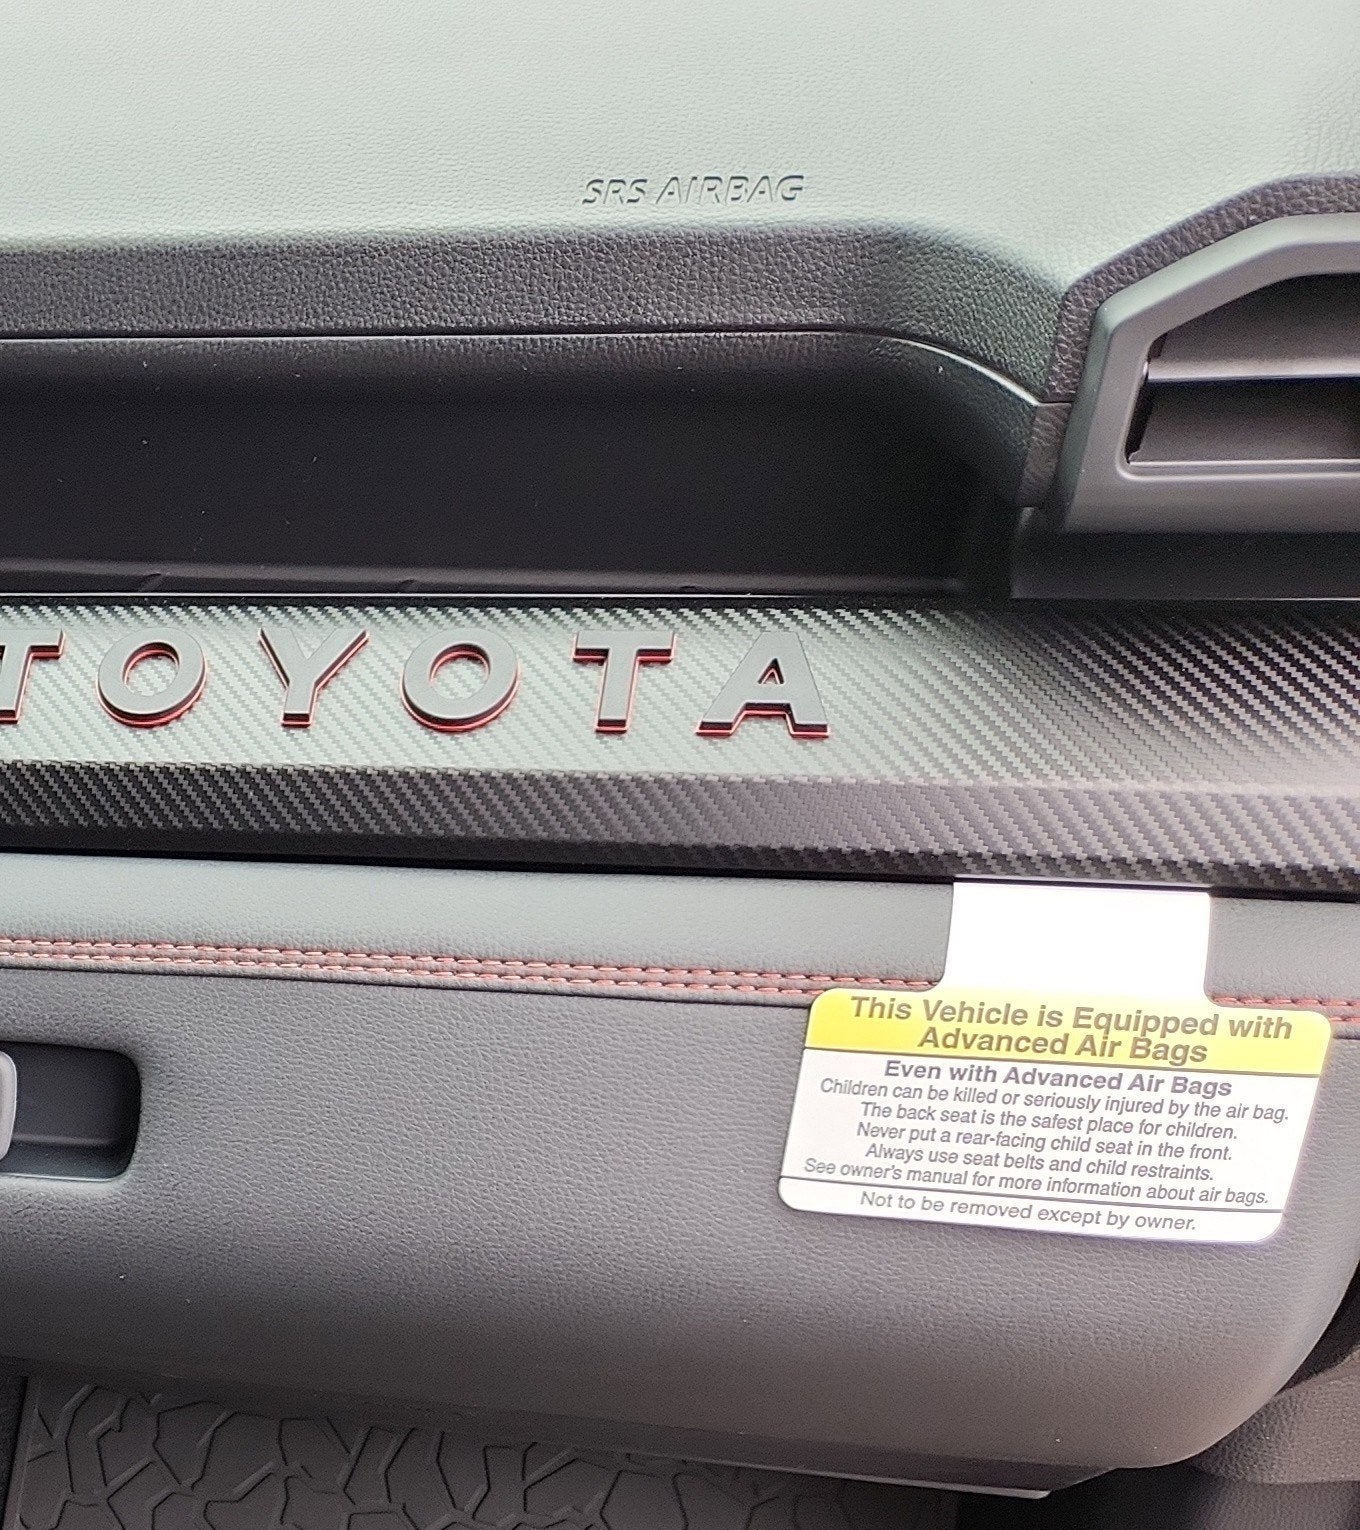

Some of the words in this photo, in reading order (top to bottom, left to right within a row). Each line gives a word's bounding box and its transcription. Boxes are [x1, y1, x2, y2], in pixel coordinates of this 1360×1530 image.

[582, 179, 648, 204] SRS
[656, 175, 804, 204] AIRBAG
[851, 996, 912, 1020] This
[923, 999, 1028, 1026] Vehicle
[1037, 1004, 1063, 1027] is
[1072, 1006, 1219, 1039] Equipped
[1228, 1015, 1293, 1039] with
[917, 1026, 1070, 1055] Advanced
[1074, 1034, 1122, 1058] Air
[1129, 1036, 1208, 1066] Bags
[885, 1059, 941, 1080] Even
[949, 1064, 997, 1083] with
[1002, 1066, 1124, 1090] Advanced
[1127, 1074, 1164, 1093] Air
[1171, 1076, 1232, 1099] Bags
[820, 1077, 888, 1097] Children
[892, 1084, 922, 1099] can
[927, 1084, 948, 1101] be
[953, 1086, 998, 1104] killed
[1001, 1091, 1020, 1105] or
[1023, 1091, 1101, 1113] seriously
[1105, 1096, 1164, 1115] injured
[1168, 1099, 1190, 1119] by
[1194, 1101, 1221, 1118] the
[1226, 1103, 1249, 1119] air
[1252, 1104, 1289, 1124] bag.
[861, 1101, 892, 1118] The
[896, 1103, 937, 1121] back
[940, 1108, 976, 1124] seat
[981, 1110, 995, 1125] is
[1000, 1111, 1027, 1127] the
[1031, 1112, 1083, 1131] safest
[1086, 1117, 1133, 1134] place
[1139, 1119, 1162, 1135] for
[1165, 1122, 1237, 1139] children.
[857, 1122, 905, 1139] Never
[908, 1127, 936, 1143] put
[940, 1131, 951, 1143] a
[956, 1131, 1046, 1152] rear-facing
[1050, 1136, 1091, 1152] child
[1095, 1141, 1133, 1155] seat
[1137, 1141, 1152, 1156] in
[1158, 1142, 1185, 1158] the
[1189, 1144, 1232, 1160] front.
[804, 1157, 836, 1174] See
[840, 1164, 902, 1180] owner's
[906, 1170, 968, 1185] manual
[971, 1171, 994, 1187] for
[999, 1176, 1042, 1190] more
[1047, 1178, 1142, 1198] information
[1146, 1184, 1195, 1200] about
[1199, 1187, 1221, 1202] air
[1225, 1188, 1269, 1206] bags.
[865, 1143, 924, 1164] Always
[928, 1150, 959, 1164] use
[963, 1152, 1000, 1168] seat
[1004, 1153, 1045, 1171] belts
[1049, 1158, 1082, 1173] and
[1086, 1159, 1126, 1175] child
[1131, 1163, 1213, 1181] restraints.
[860, 1191, 893, 1208] Not
[898, 1194, 915, 1209] to
[921, 1196, 944, 1212] be
[949, 1200, 1032, 1220] removed
[1038, 1208, 1101, 1227] except
[1107, 1211, 1129, 1229] by
[1135, 1215, 1196, 1231] owner.
